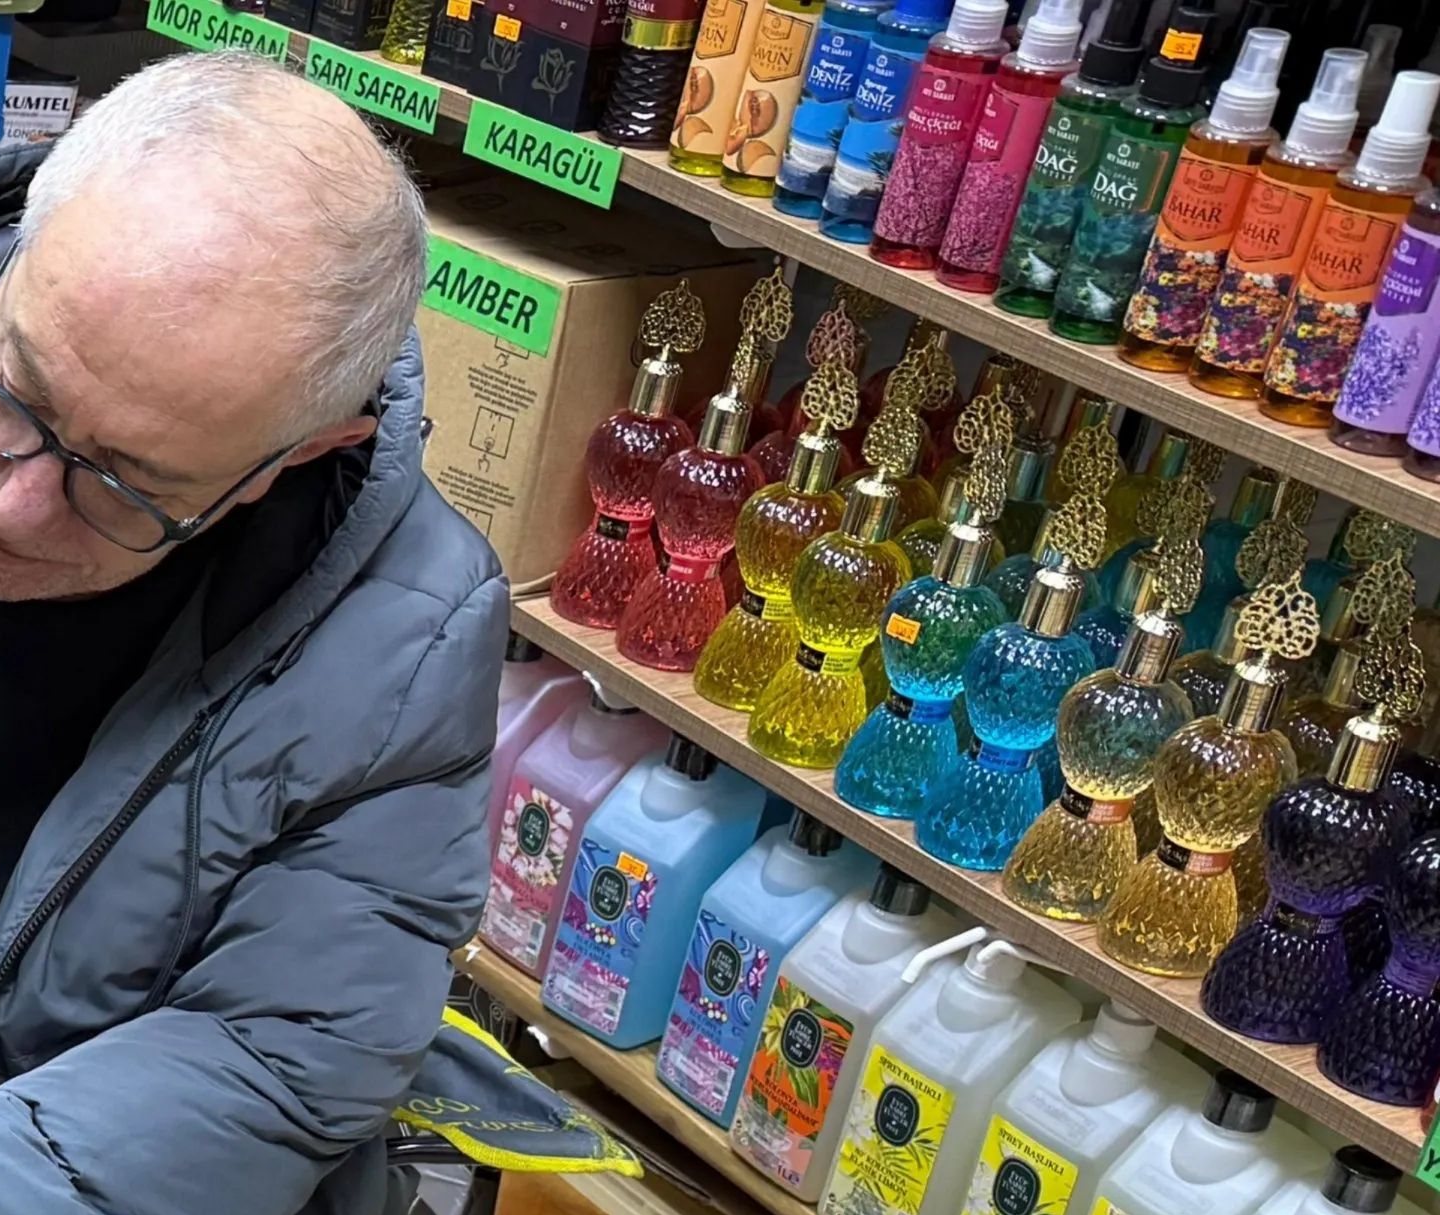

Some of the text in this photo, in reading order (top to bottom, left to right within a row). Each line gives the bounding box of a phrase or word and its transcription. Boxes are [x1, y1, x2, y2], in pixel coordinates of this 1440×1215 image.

[152, 0, 285, 60] MOR SAFRAN
[308, 53, 437, 124] SARI SAFRAN
[810, 65, 853, 87] DENİZ
[4, 96, 71, 111] KUMTEL
[485, 121, 604, 193] KARAGÜL
[1093, 172, 1138, 202] DAĞ
[427, 260, 539, 333] AMBER
[998, 1128, 1065, 1176] SPREY BAŞLIKLI
